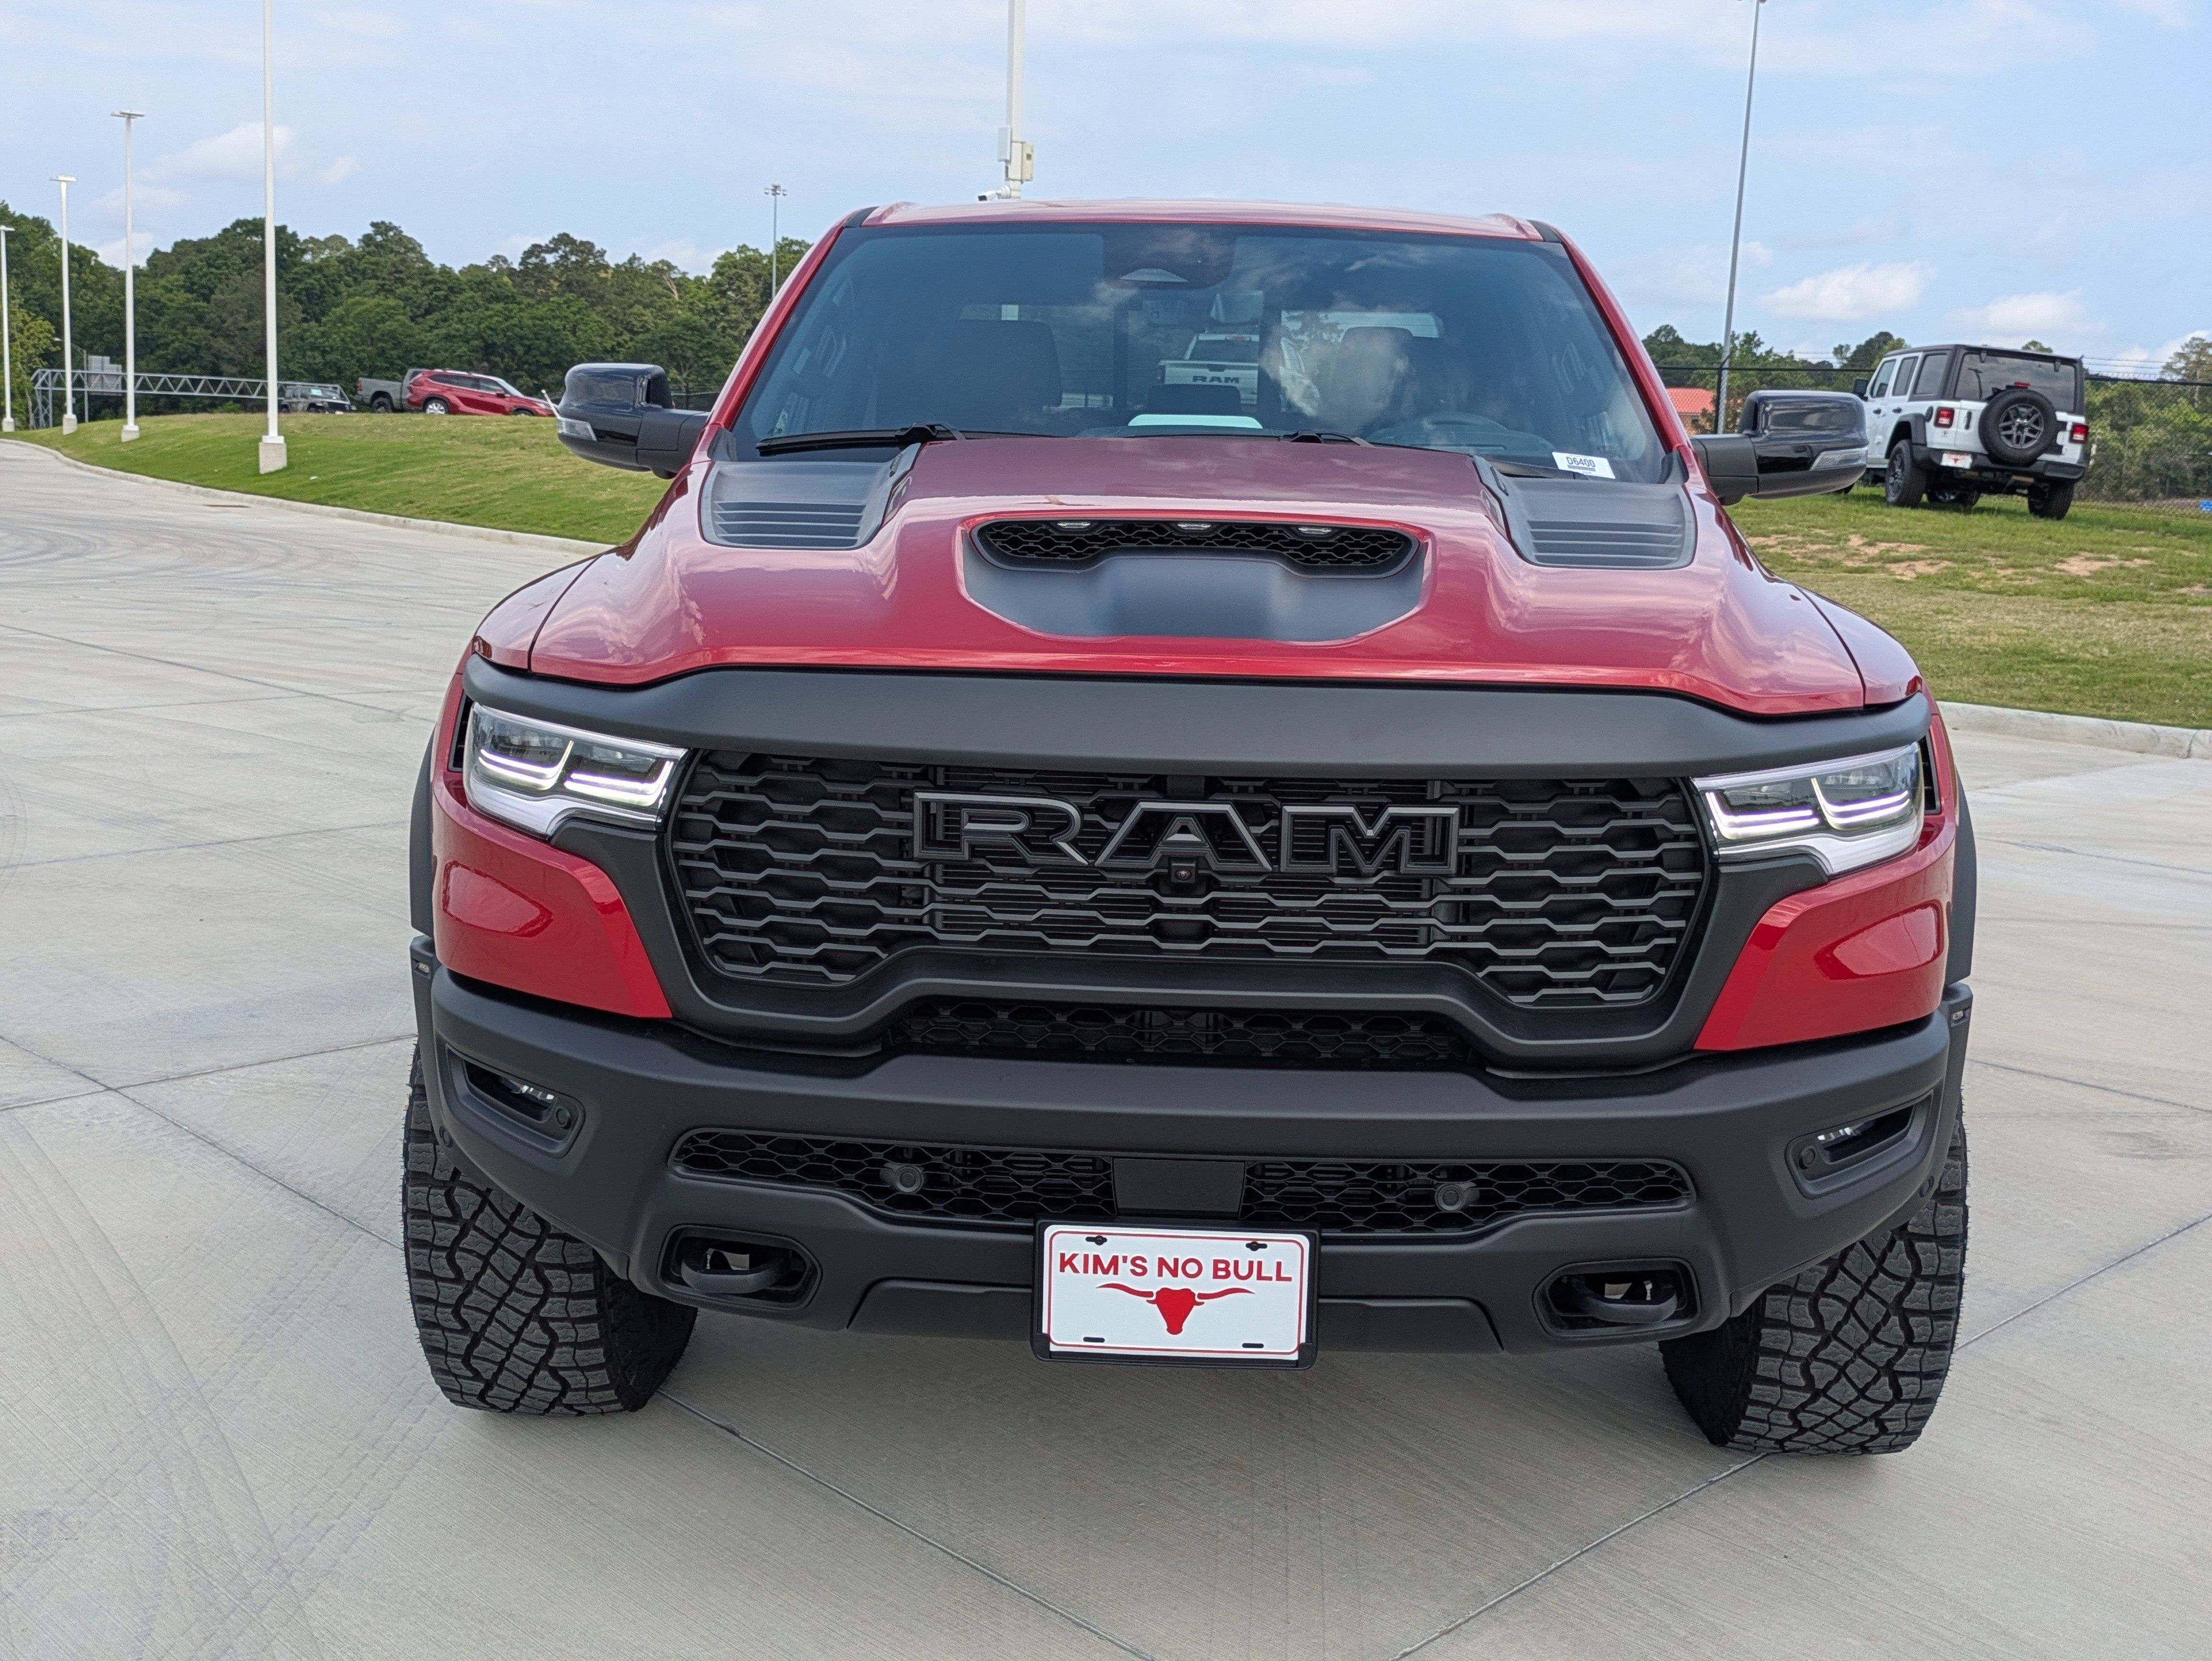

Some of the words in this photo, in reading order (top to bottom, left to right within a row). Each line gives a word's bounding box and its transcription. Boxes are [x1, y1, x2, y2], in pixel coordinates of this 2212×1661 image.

[1193, 376, 1239, 384] RAM
[1566, 456, 1595, 467] D6400
[913, 790, 1460, 875] RAM
[1059, 1252, 1148, 1277] KIM'S
[1157, 1257, 1203, 1279] NO
[1212, 1259, 1293, 1282] BULL
